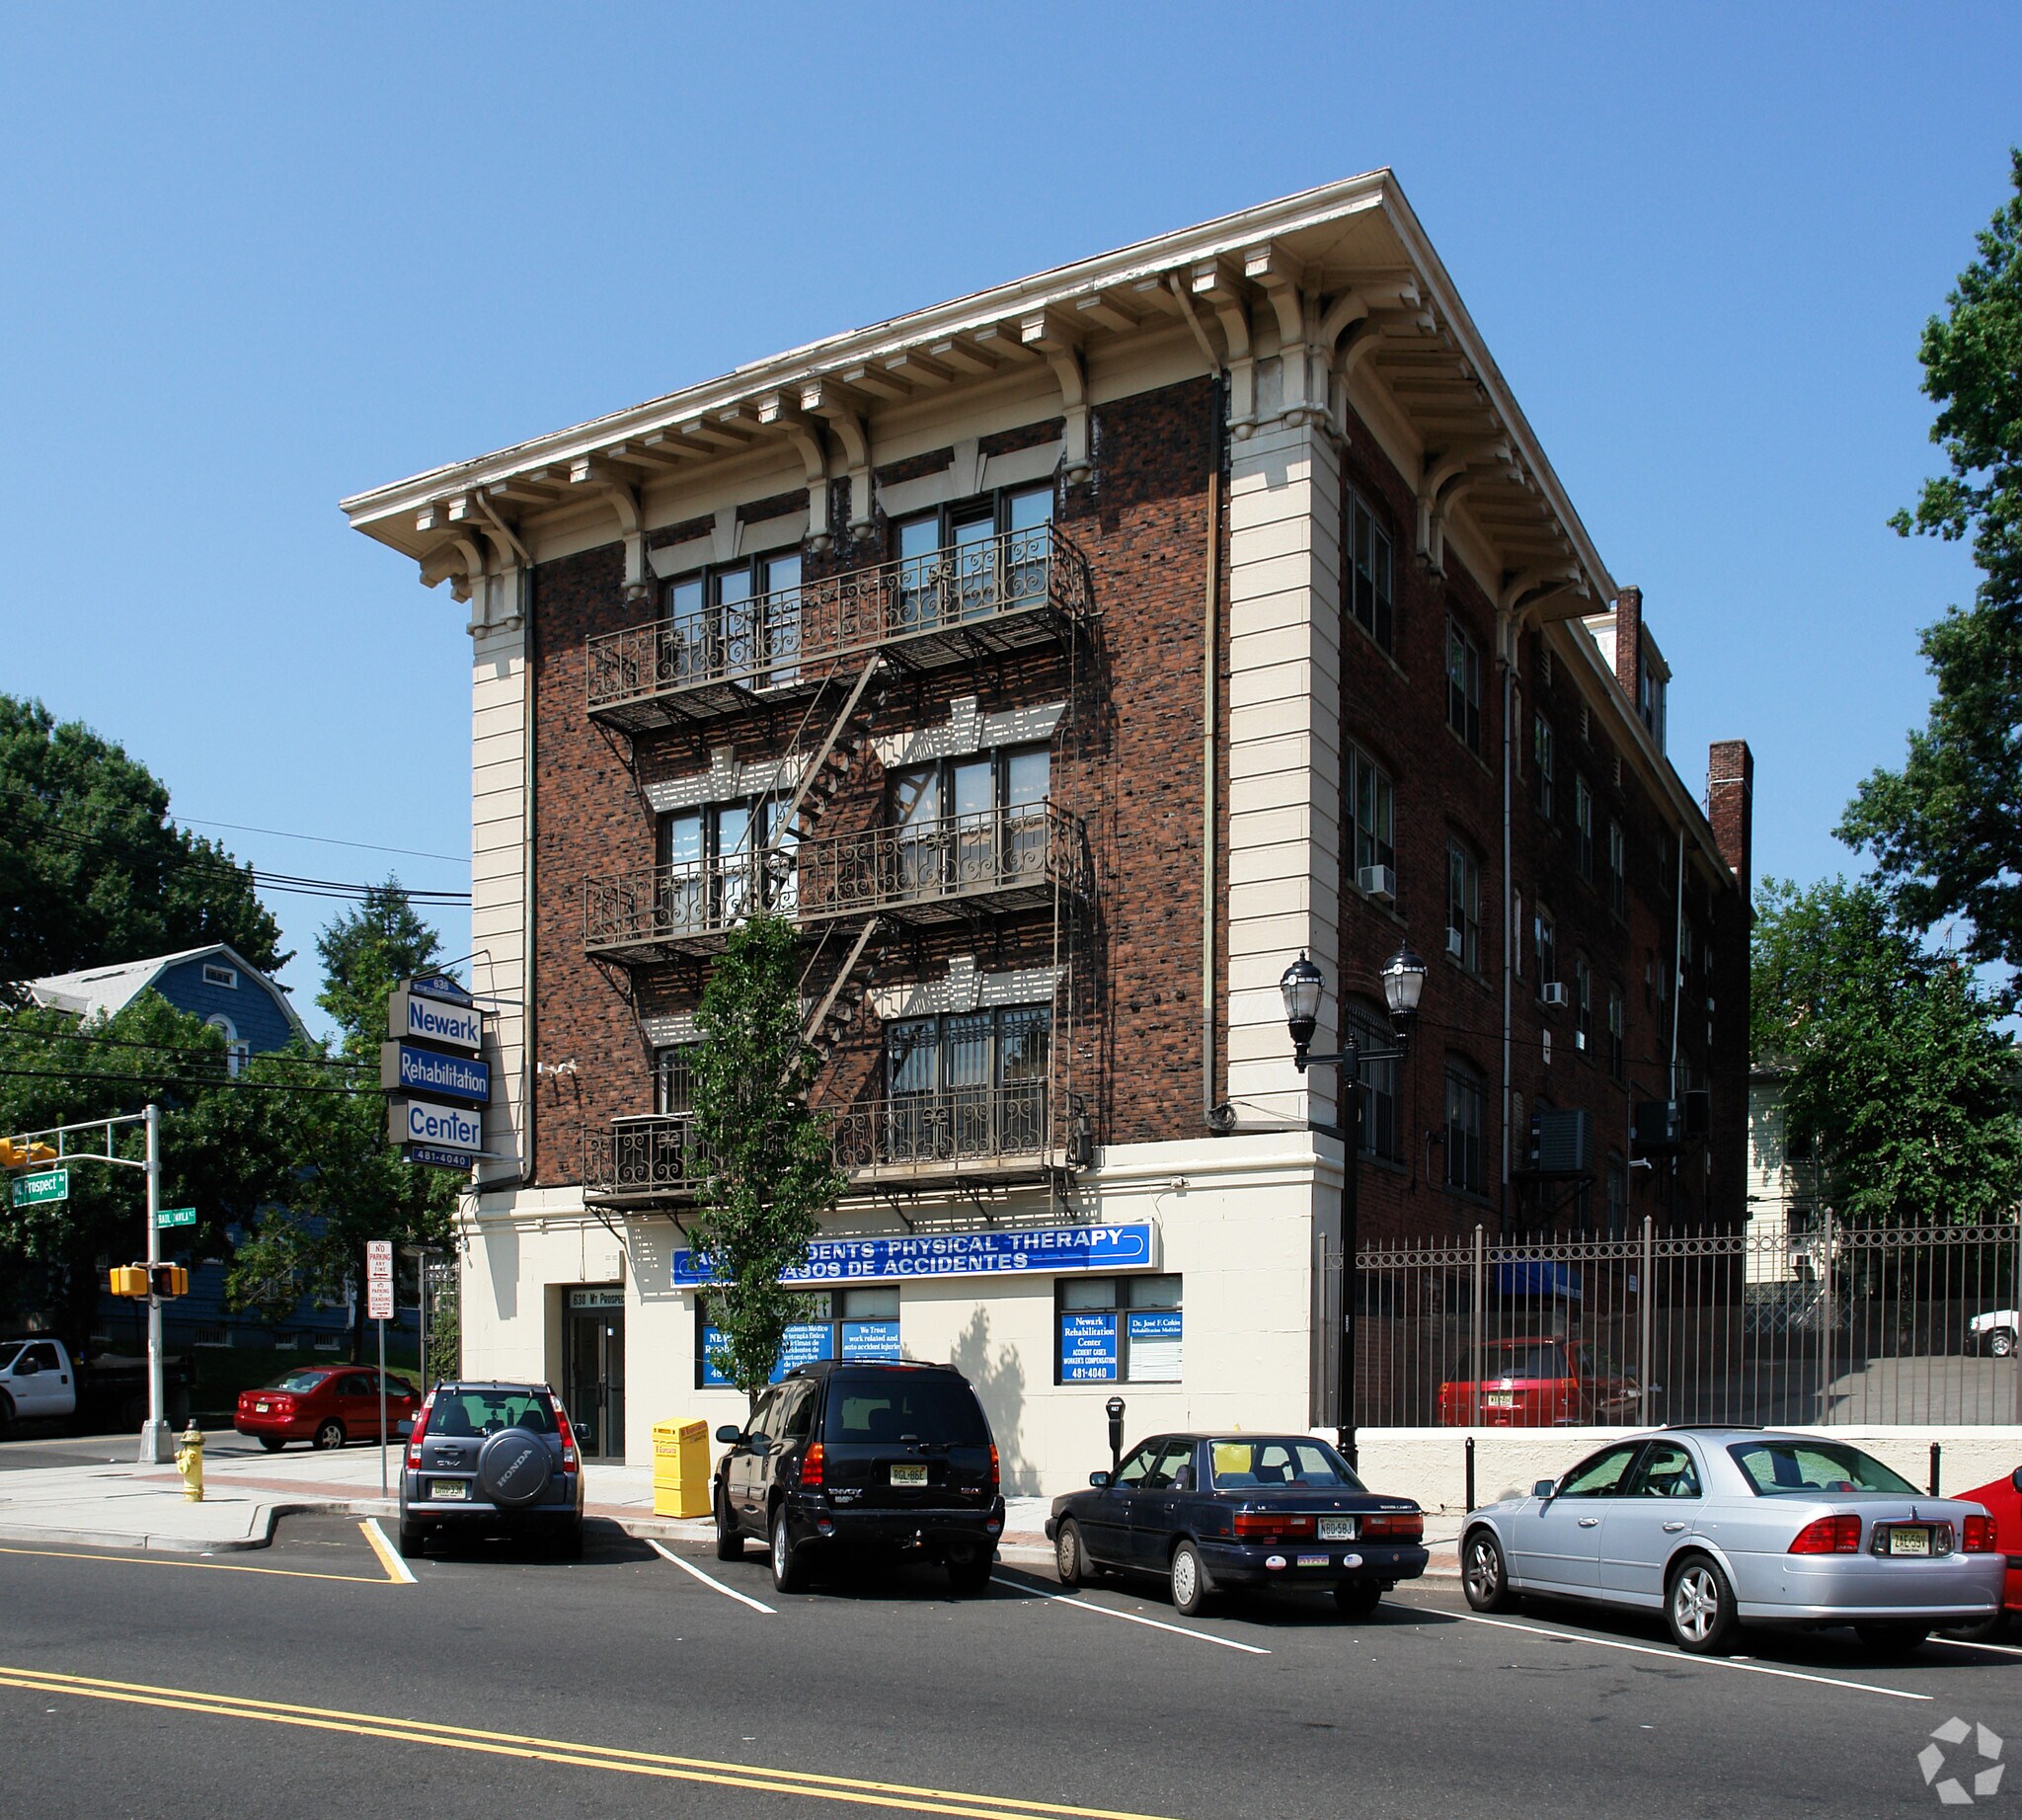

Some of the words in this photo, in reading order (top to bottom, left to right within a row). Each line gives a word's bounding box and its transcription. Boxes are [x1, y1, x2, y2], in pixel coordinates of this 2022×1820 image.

[410, 1001, 478, 1042] Newark
[402, 1053, 487, 1093] Rehabilitation
[410, 1107, 479, 1144] Center
[418, 1149, 466, 1165] 481-4040
[25, 1175, 57, 1196] Prospect
[375, 1244, 385, 1253] NO
[889, 1235, 998, 1256] PHYSICAL
[1009, 1228, 1124, 1250] THERAPY
[779, 1261, 841, 1279] ASOS
[848, 1260, 876, 1276] DE
[884, 1252, 1028, 1274] ACCIDENTES
[574, 1294, 585, 1306] 638
[1064, 1327, 1115, 1336] Rehabilitation
[1075, 1316, 1104, 1326] Newark
[497, 1448, 532, 1488] HONDA
